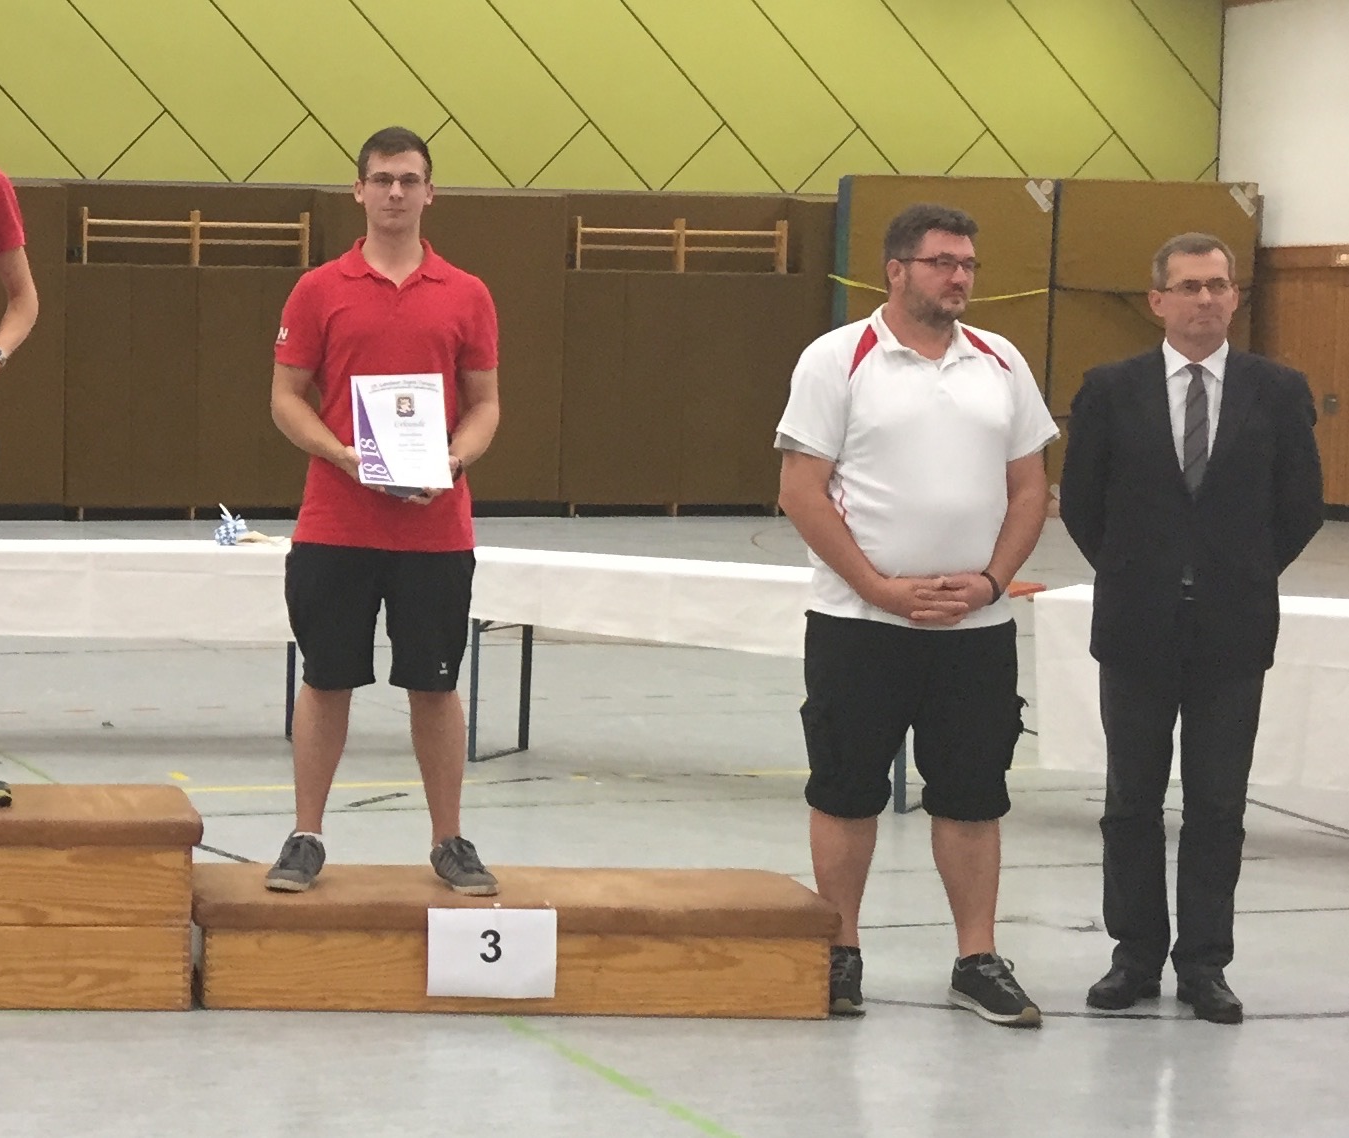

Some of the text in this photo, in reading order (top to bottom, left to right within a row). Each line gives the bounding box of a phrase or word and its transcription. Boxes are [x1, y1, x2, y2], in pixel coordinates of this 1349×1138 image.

[360, 437, 391, 482] 18 18
[478, 929, 502, 963] 3
